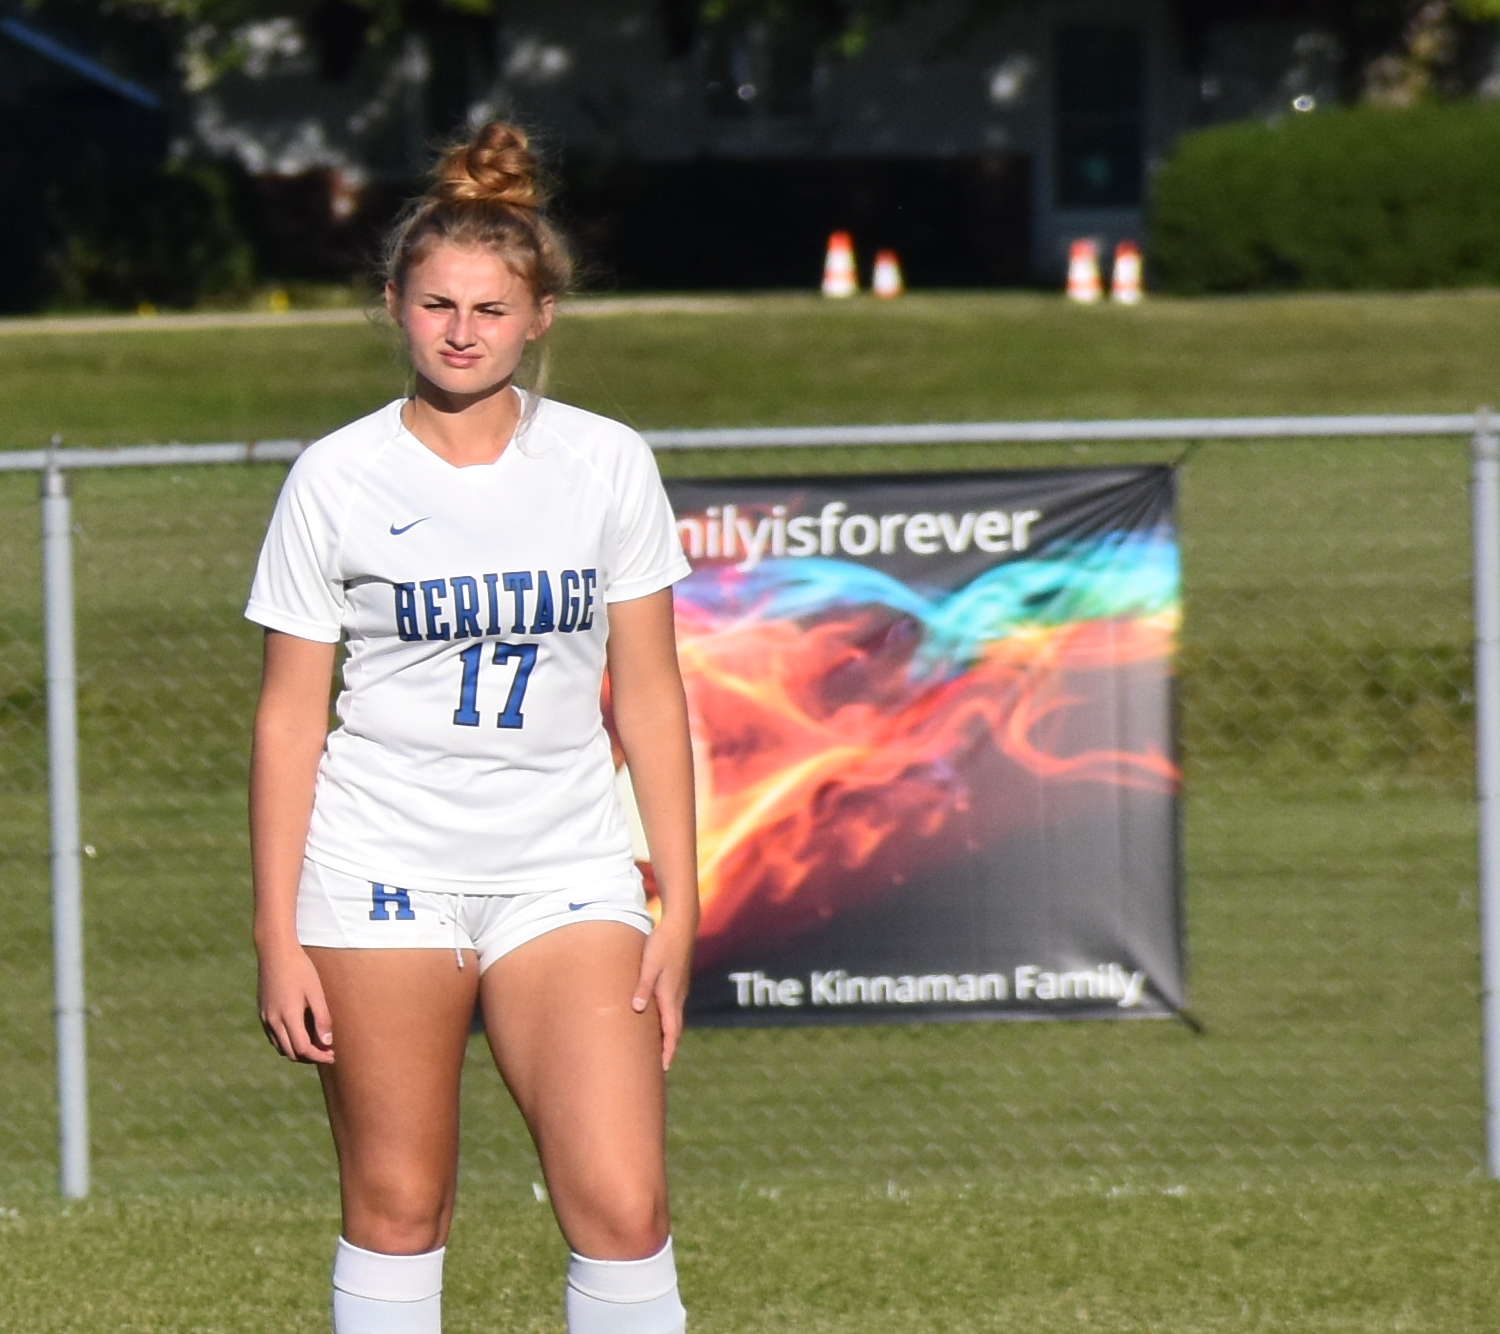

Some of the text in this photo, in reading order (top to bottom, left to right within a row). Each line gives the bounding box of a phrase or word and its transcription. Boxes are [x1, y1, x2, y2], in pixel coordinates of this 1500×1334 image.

[393, 569, 597, 642] HERITAGE
[452, 642, 540, 730] 17
[729, 963, 1146, 1007] The Kinnaman Family
